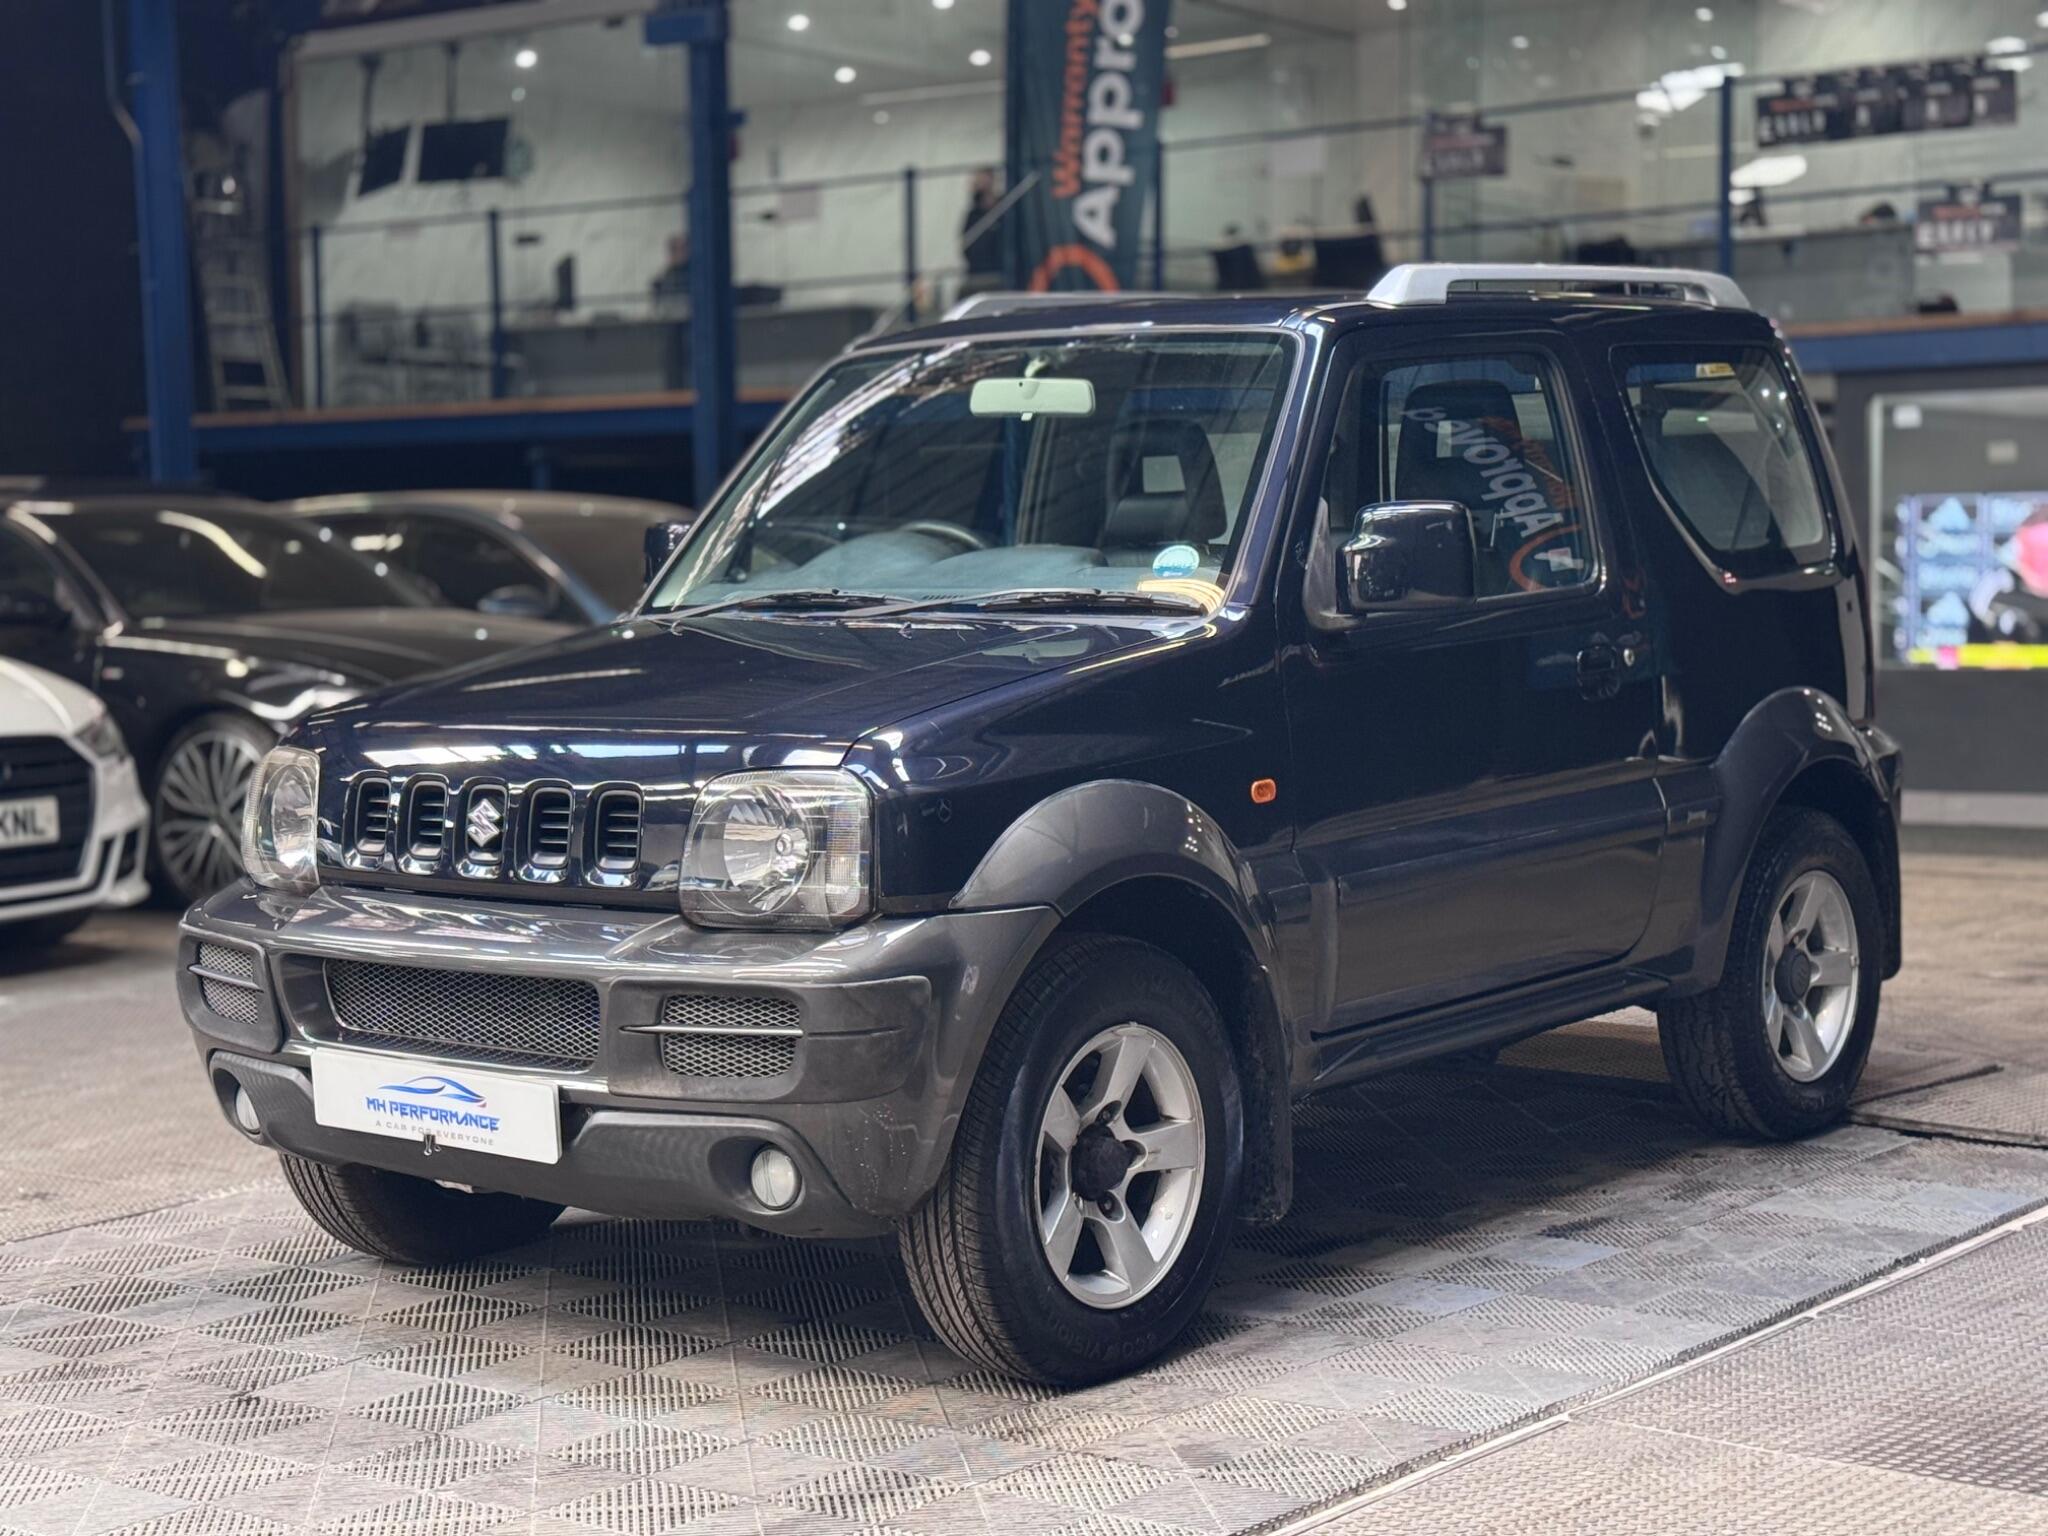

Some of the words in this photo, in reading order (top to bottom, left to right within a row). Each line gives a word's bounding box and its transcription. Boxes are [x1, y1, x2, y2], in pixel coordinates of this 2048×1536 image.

[389, 1101, 500, 1132] PERFORMANCE
[386, 1121, 408, 1131] CAR
[436, 1130, 495, 1146] EVERYONE
